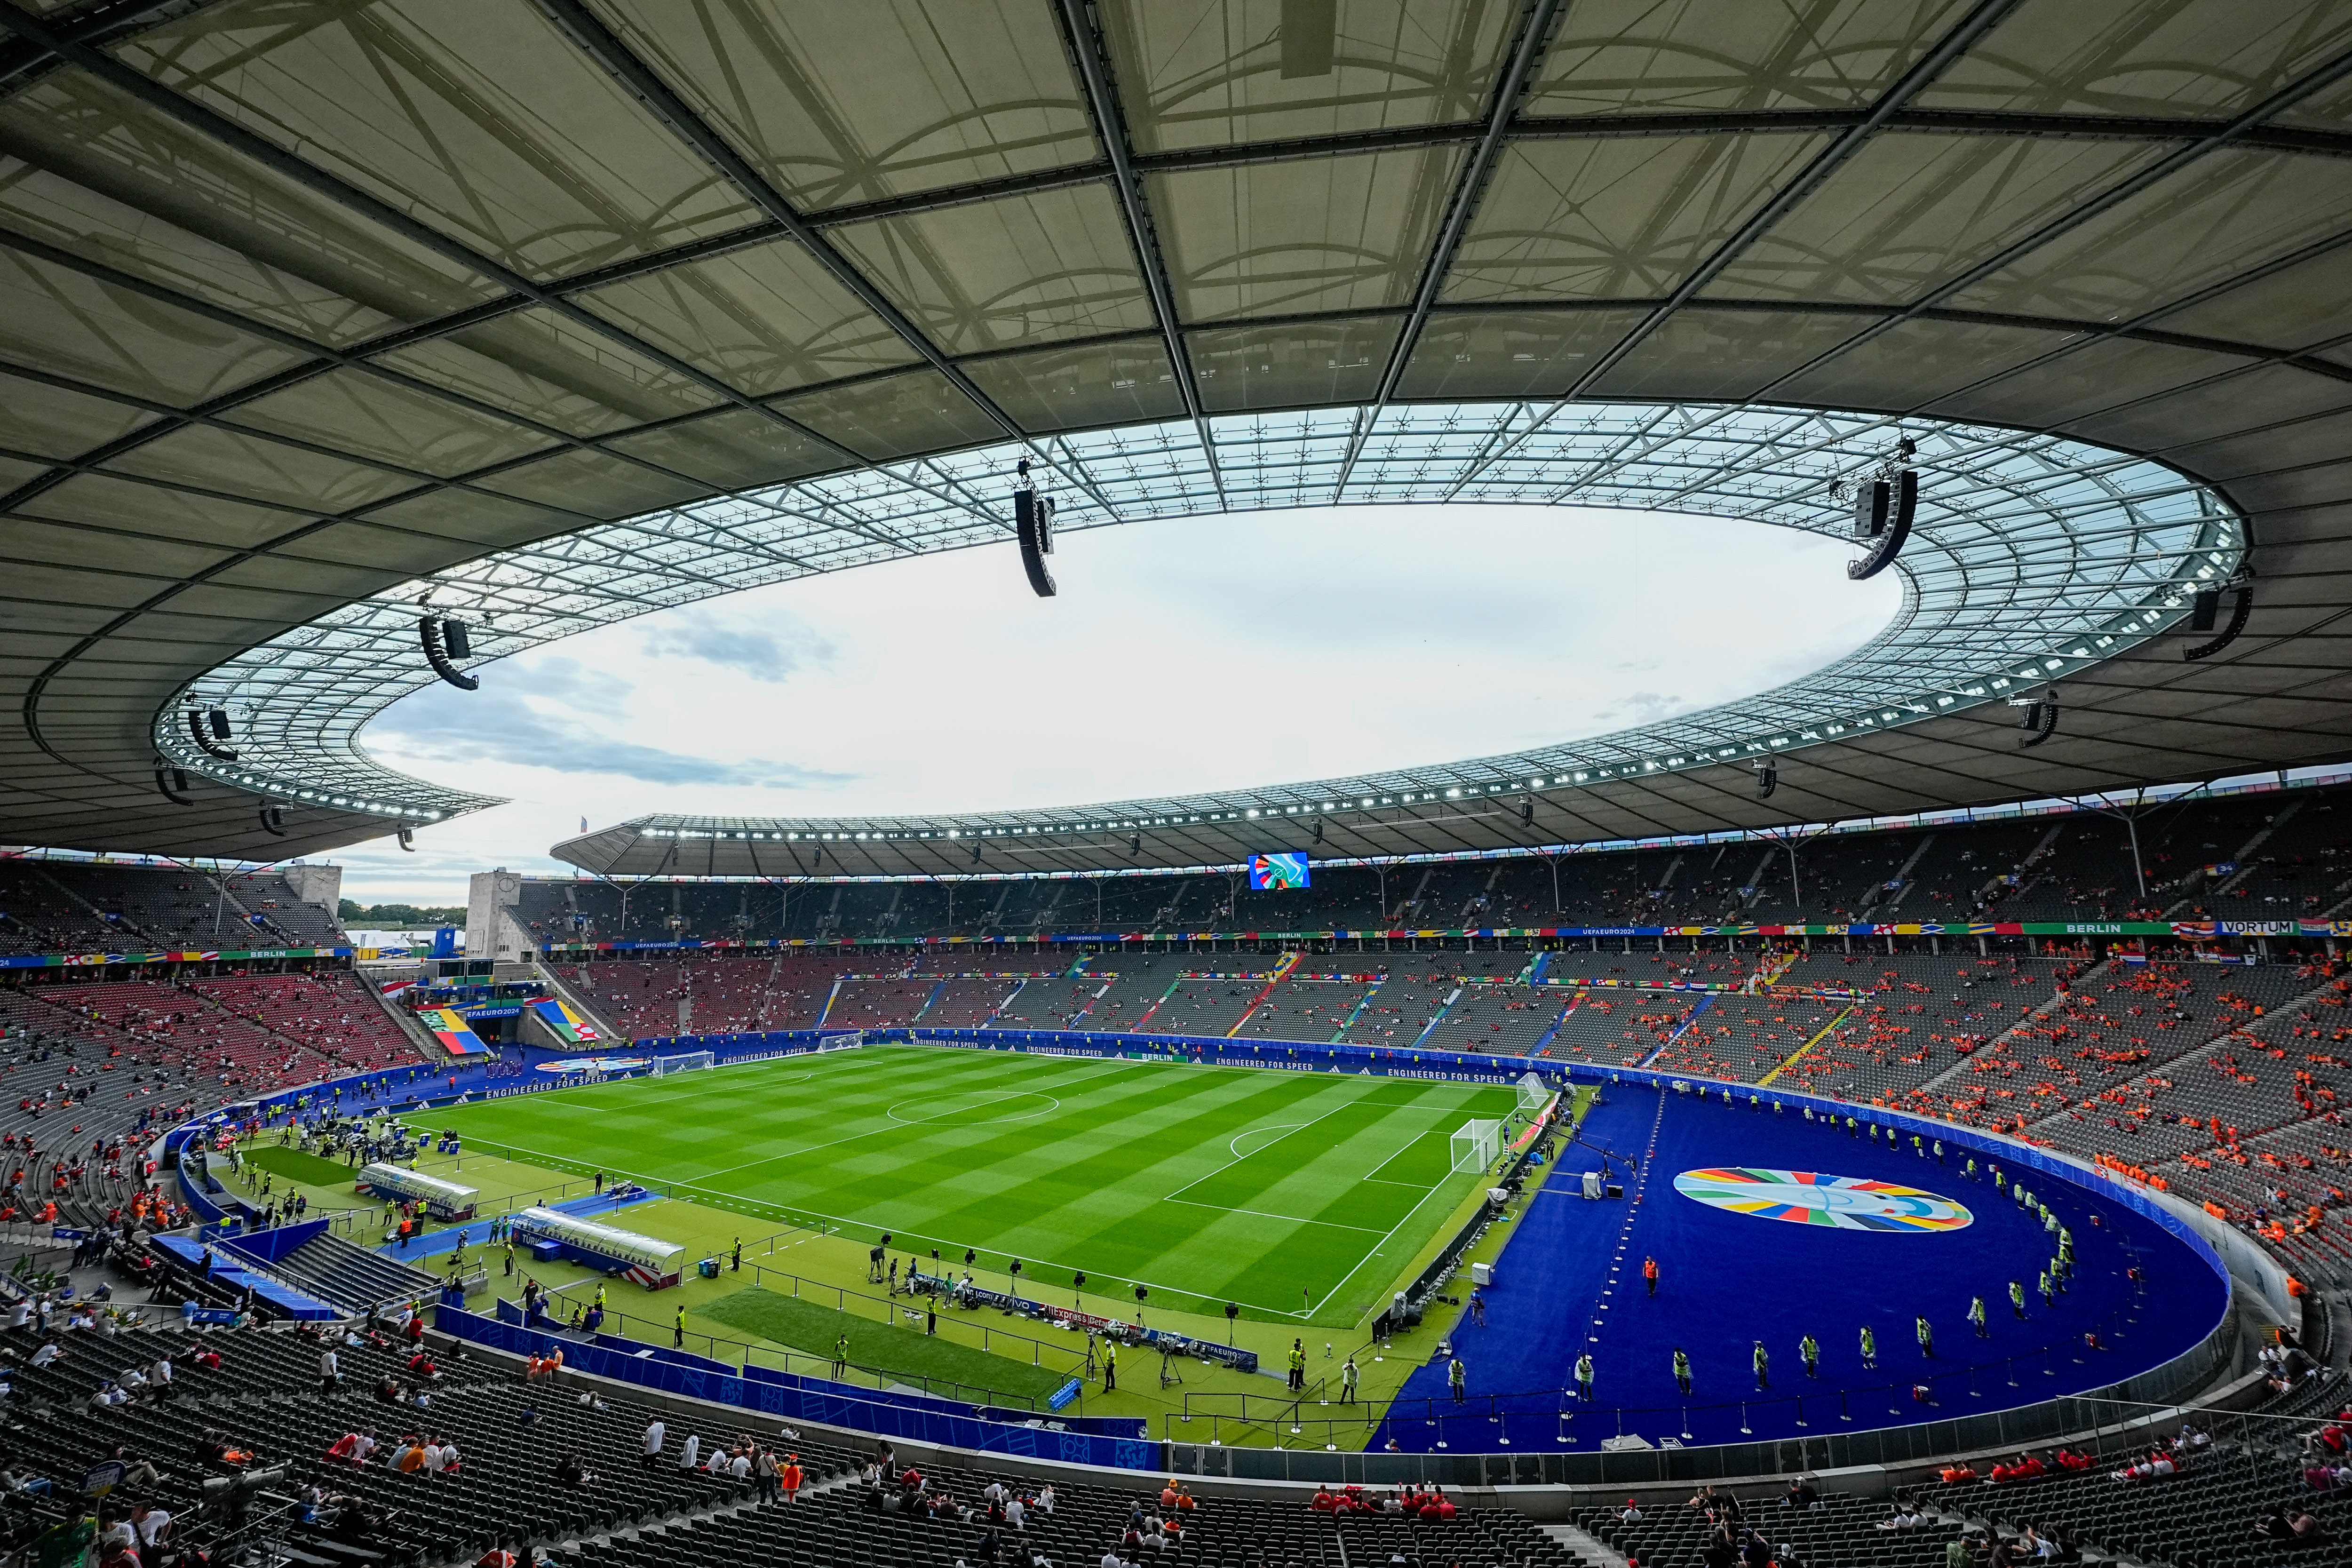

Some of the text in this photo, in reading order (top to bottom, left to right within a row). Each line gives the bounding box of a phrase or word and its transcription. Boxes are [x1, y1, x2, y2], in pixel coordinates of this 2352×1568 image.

[2066, 924, 2121, 933] BERLIN
[2225, 922, 2290, 933] VORTUM
[723, 1052, 768, 1064] ENGINEERED
[786, 1047, 807, 1056] SPEED
[1026, 1046, 1065, 1054] ENGINEERED
[1142, 1053, 1173, 1062] BERLIN
[1216, 1058, 1265, 1068] ENGINEERED
[1287, 1062, 1313, 1071] SPEED
[1388, 1068, 1506, 1084] ENGINEERED FOR SPEED
[486, 1075, 608, 1099] ENGINEERED FOR SPEED
